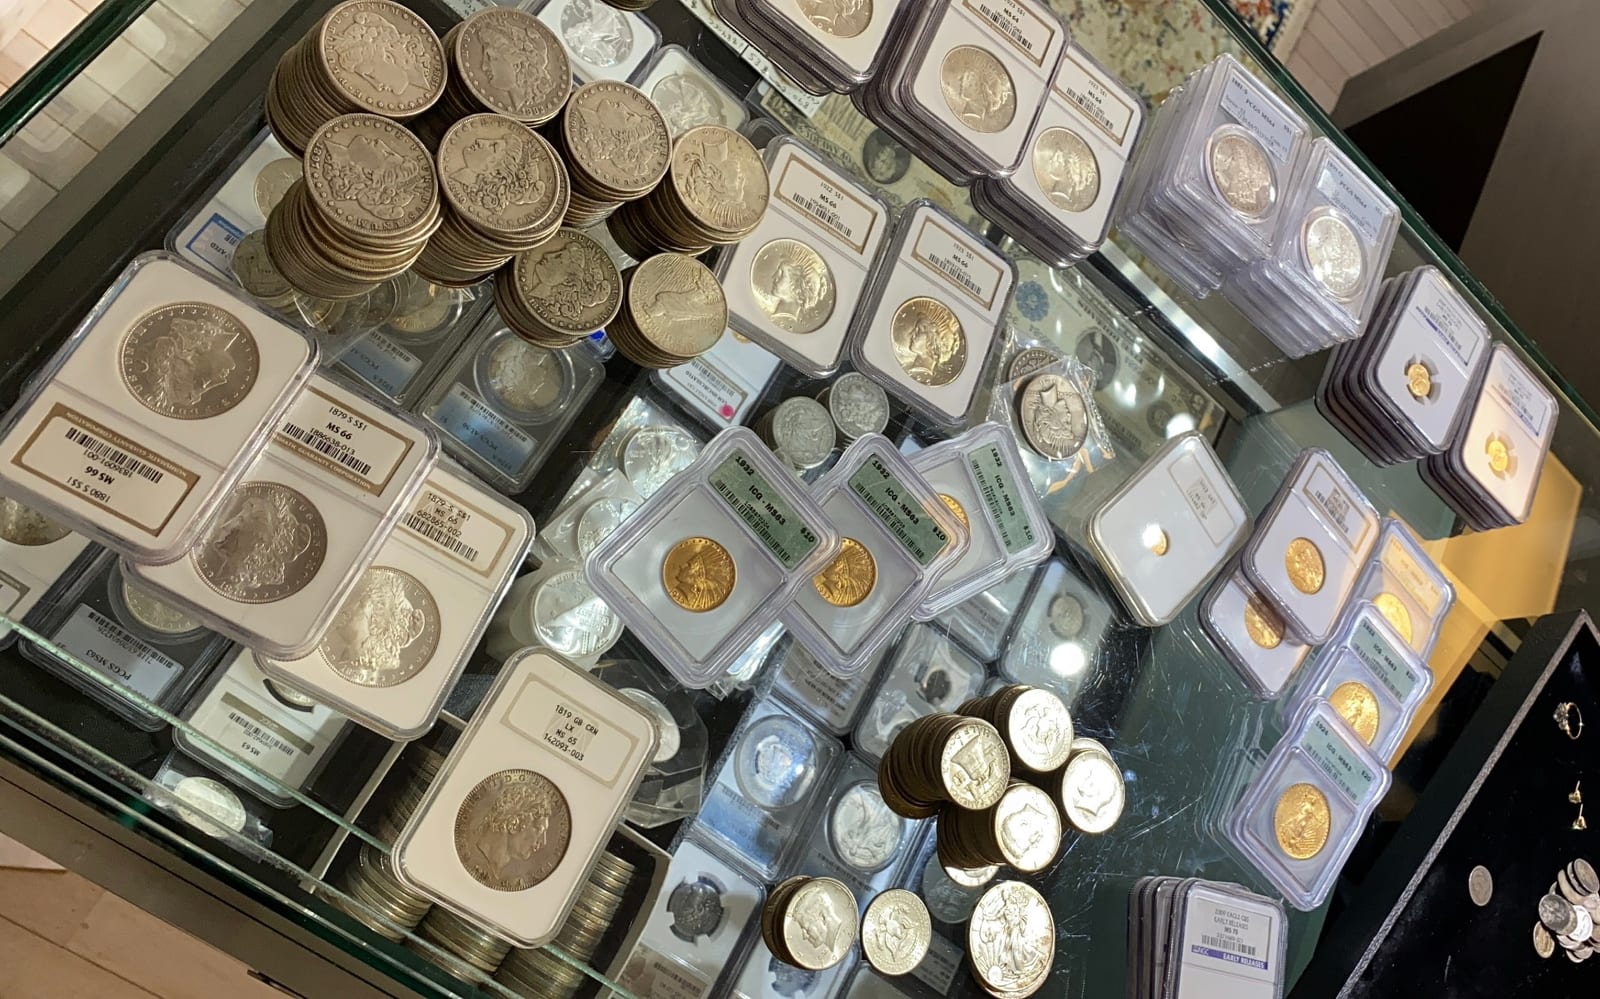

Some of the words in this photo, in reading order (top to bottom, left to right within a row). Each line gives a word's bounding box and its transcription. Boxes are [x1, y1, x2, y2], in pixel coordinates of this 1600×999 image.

[1004, 8, 1012, 18] MS
[1246, 99, 1261, 114] PCGS
[819, 194, 829, 204] MS
[952, 254, 961, 263] MS
[328, 406, 347, 420] 1879
[66, 412, 113, 442] CORPORATION
[326, 422, 340, 434] MS
[340, 430, 352, 440] 66
[114, 436, 149, 456] GUARANTY
[990, 447, 1002, 467] 1932
[85, 466, 98, 477] 66
[299, 448, 330, 467] GUARANTY
[330, 464, 371, 489] CORPORATION
[735, 456, 755, 476] 1932
[872, 460, 890, 479] 1932
[98, 472, 115, 485] MS
[83, 483, 90, 492] S
[90, 487, 111, 503] 1880
[427, 492, 446, 506] 1879
[995, 474, 1004, 490] ICG
[1002, 494, 1015, 517] MS63
[434, 508, 445, 517] MS
[749, 485, 763, 500] ICG
[765, 503, 786, 526] MS63
[885, 487, 898, 502] ICG
[900, 504, 920, 525] MS63
[417, 510, 462, 538] 682865-002
[800, 527, 815, 542] $10
[932, 526, 946, 541] $10
[1023, 525, 1033, 540] $10
[86, 649, 106, 666] MS63
[108, 662, 131, 680] PCGS
[555, 705, 572, 719] 1819
[574, 716, 583, 727] GB
[584, 723, 599, 736] CRN
[565, 723, 575, 733] LX
[556, 729, 566, 738] MS
[568, 736, 578, 746] 65
[241, 742, 251, 750] 63
[251, 748, 262, 756] MS
[543, 733, 585, 762] 142093-003
[1326, 743, 1336, 754] ICG
[1361, 770, 1371, 782] $20
[1214, 916, 1228, 925] EARLY
[1228, 919, 1249, 930] RELEASES
[1223, 953, 1240, 963] EARLY
[1240, 957, 1265, 969] RELEASES
